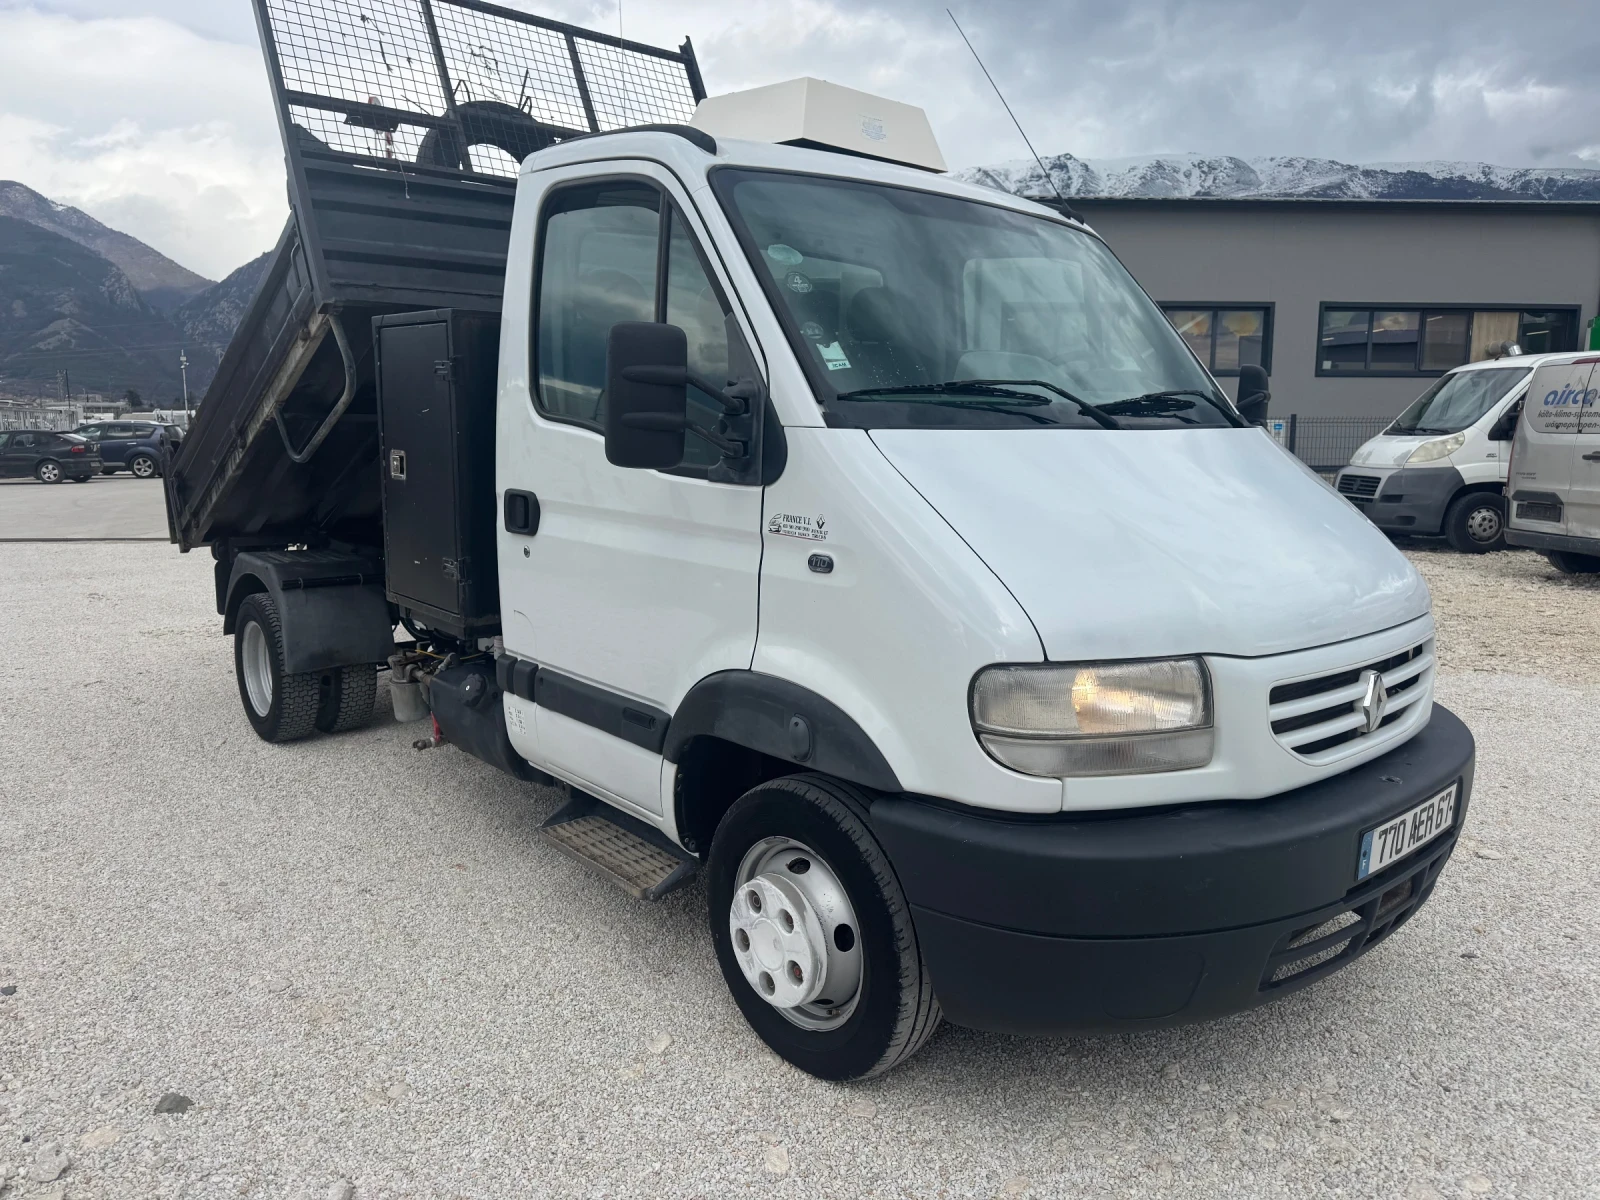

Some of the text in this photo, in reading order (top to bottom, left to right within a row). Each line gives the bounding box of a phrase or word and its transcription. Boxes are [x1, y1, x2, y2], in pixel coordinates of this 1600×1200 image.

[783, 514, 802, 524] FRANCE
[811, 556, 828, 567] 110
[1378, 790, 1453, 864] 770 AER 67
[1361, 859, 1366, 870] F
